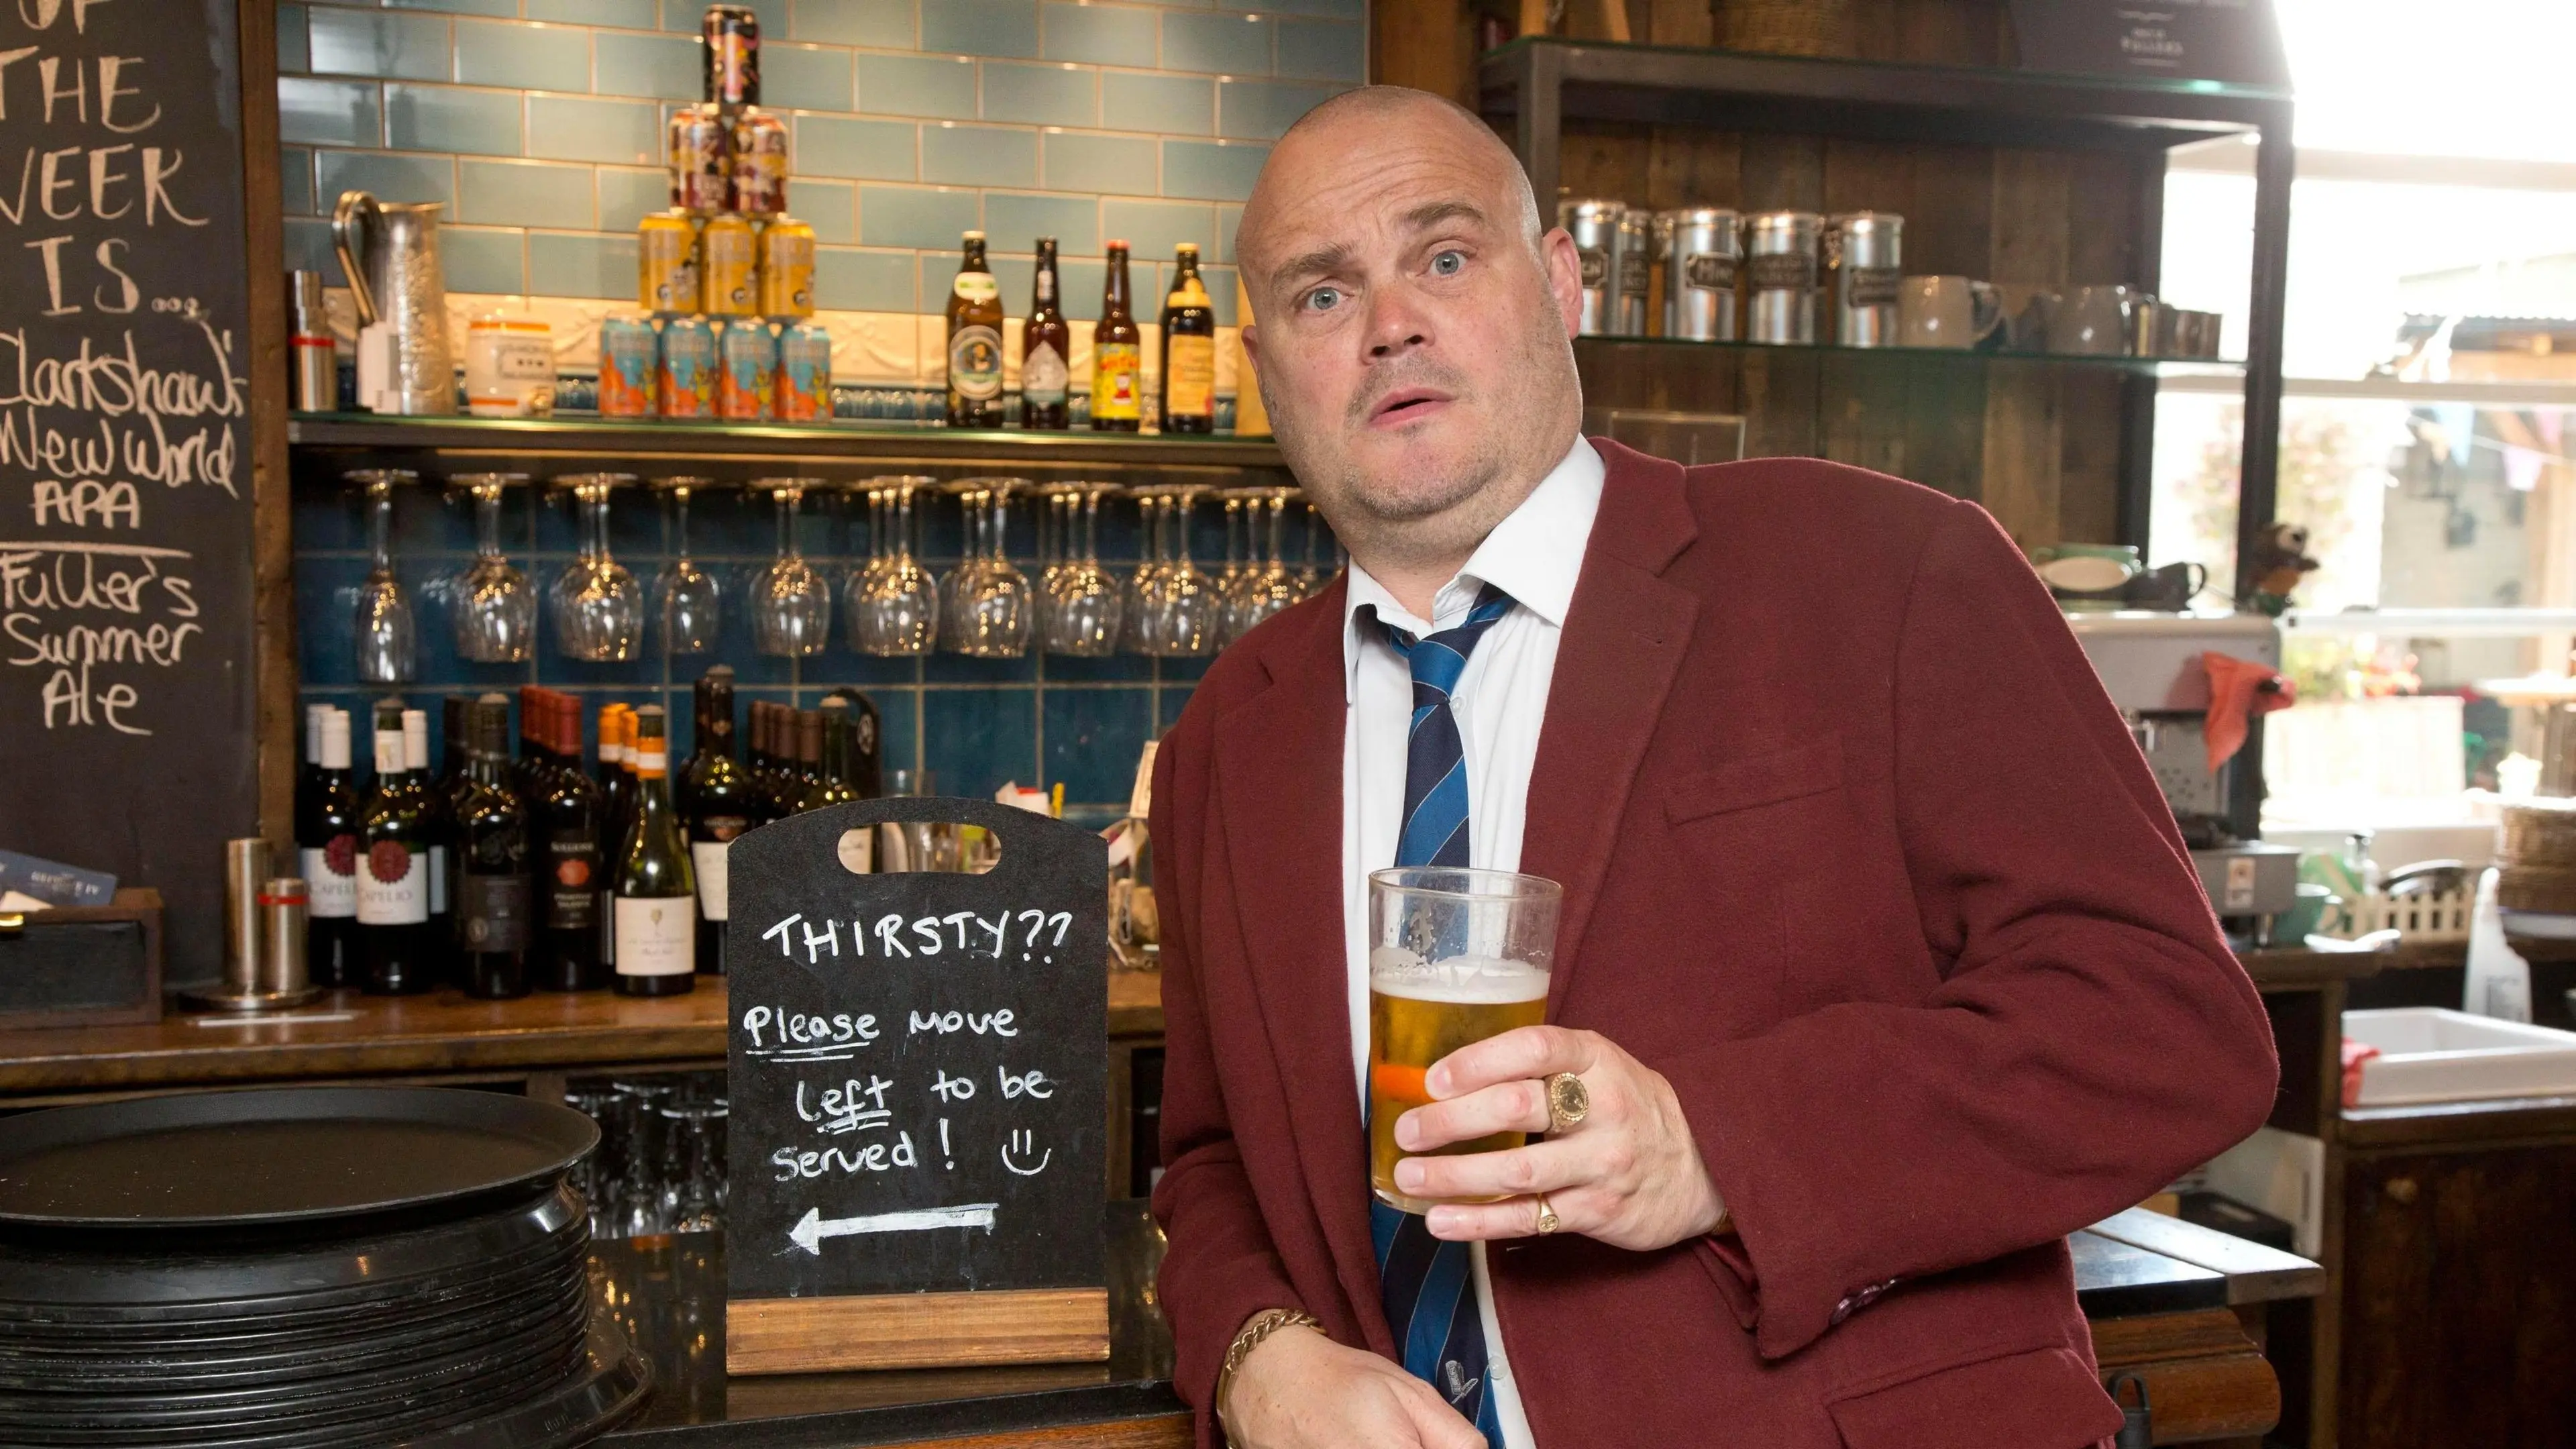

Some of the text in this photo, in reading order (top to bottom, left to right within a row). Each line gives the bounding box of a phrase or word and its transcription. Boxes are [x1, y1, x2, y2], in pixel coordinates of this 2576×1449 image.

[0, 44, 161, 133] THE
[0, 405, 113, 477] New
[0, 550, 199, 618] Fuller's
[4, 612, 203, 667] Summer
[42, 661, 152, 737] Ale
[763, 909, 1073, 963] THIRSTY??
[743, 1006, 880, 1046] Please
[930, 1069, 976, 1102] to
[998, 1065, 1053, 1100] be
